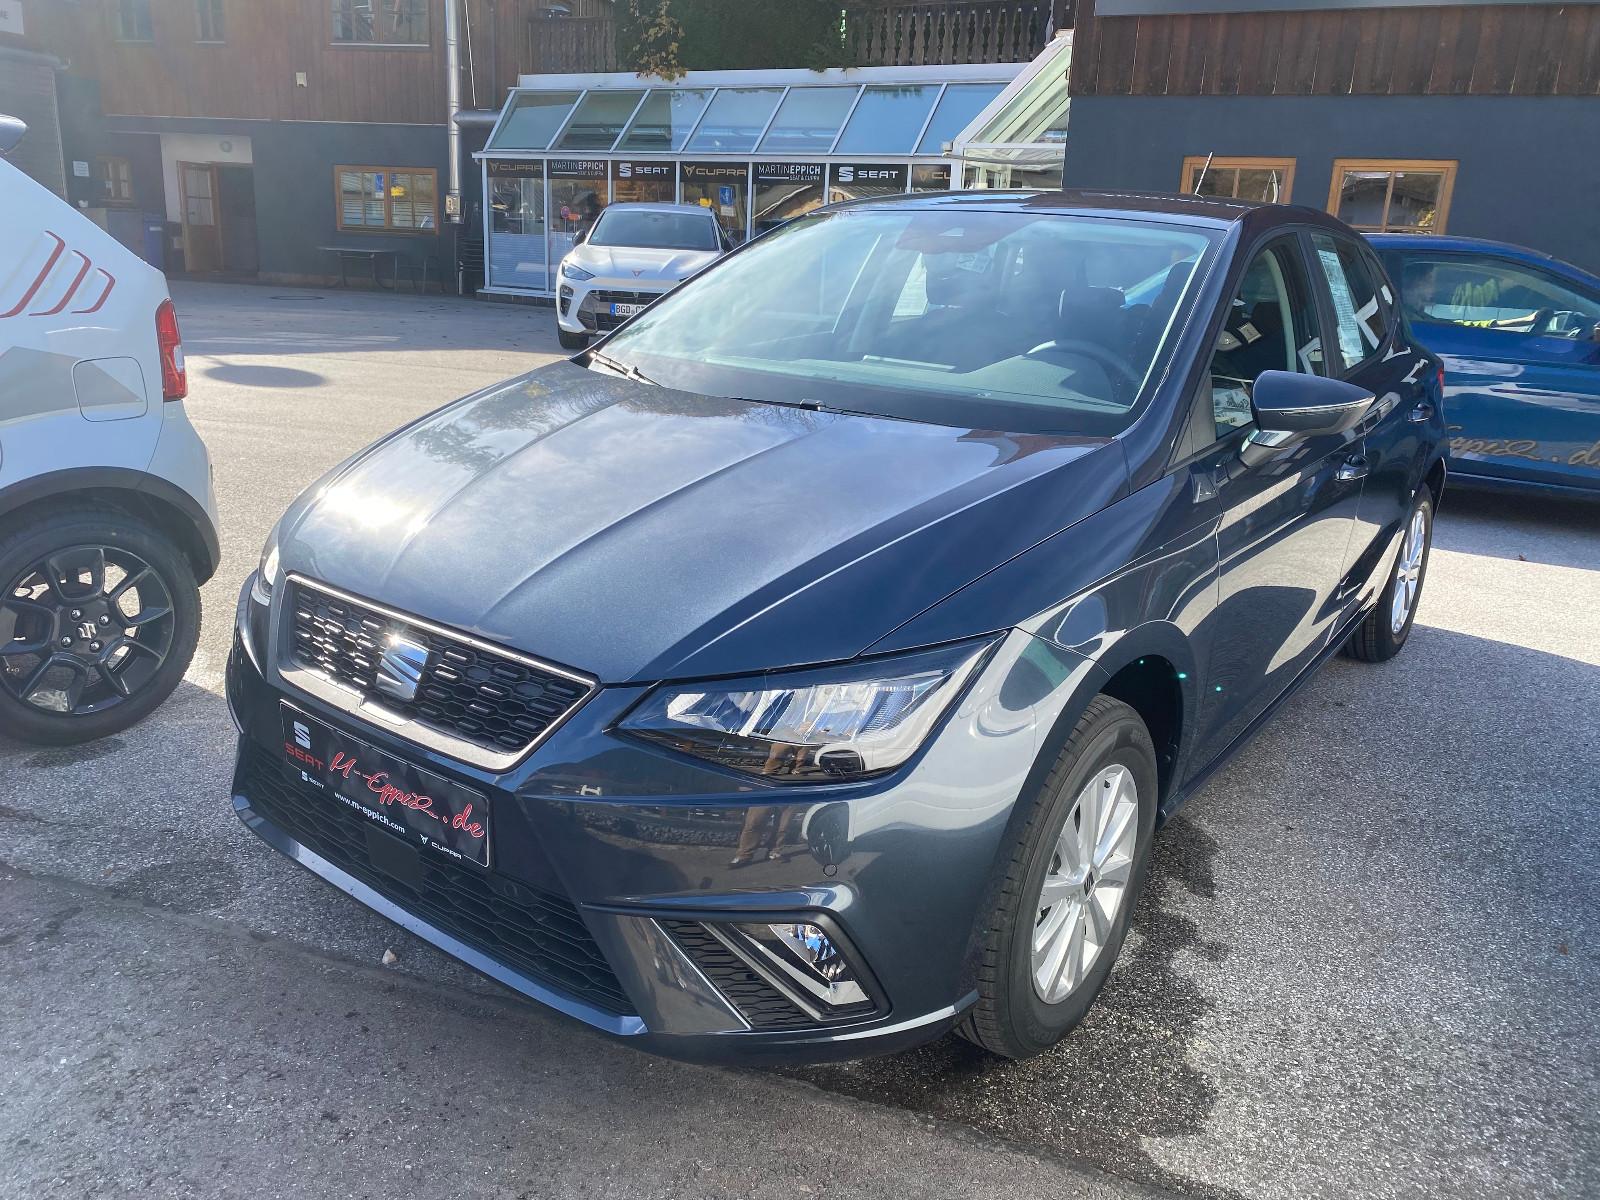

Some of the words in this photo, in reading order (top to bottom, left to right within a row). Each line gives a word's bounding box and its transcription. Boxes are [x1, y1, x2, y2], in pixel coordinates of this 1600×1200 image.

[499, 164, 543, 172] CUPRA
[635, 166, 669, 174] SEAT
[695, 168, 747, 177] CUPRA
[858, 170, 899, 179] SEAT
[615, 304, 631, 314] BGD
[285, 742, 324, 770] SEAT
[334, 791, 406, 834] www.m-eppich.com
[431, 841, 462, 860] CUPRA
